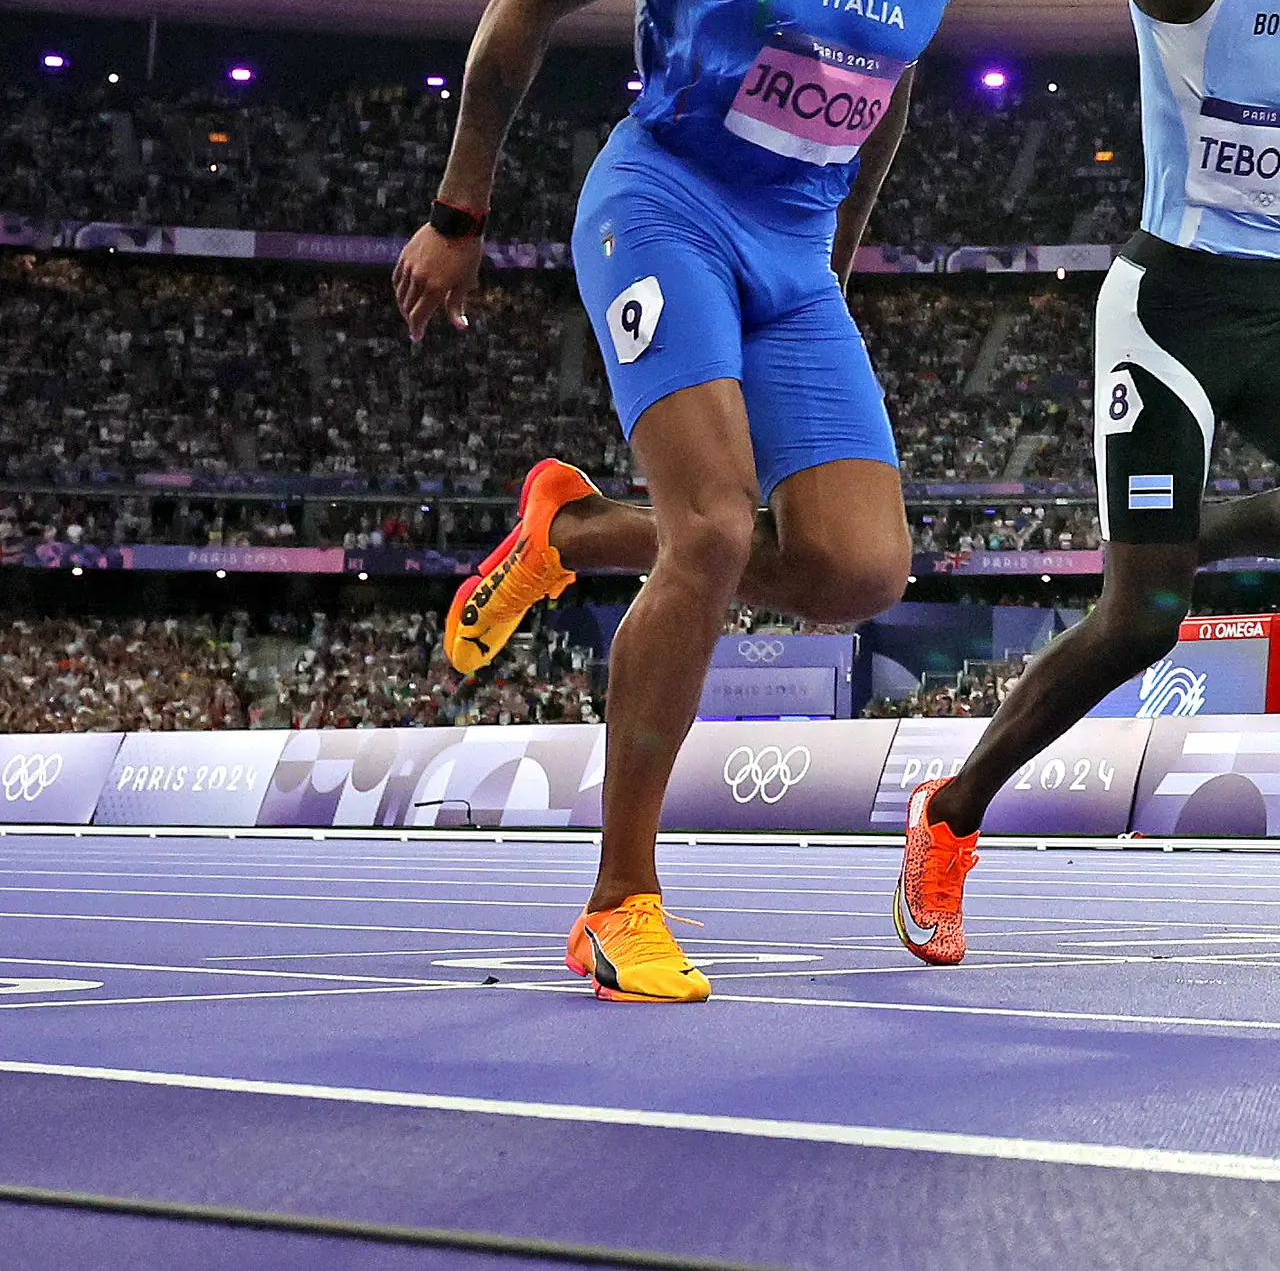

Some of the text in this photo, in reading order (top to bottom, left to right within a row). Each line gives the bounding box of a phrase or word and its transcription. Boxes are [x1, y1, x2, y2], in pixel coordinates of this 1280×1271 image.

[746, 63, 881, 131] JACOBS
[1242, 110, 1278, 122] PARIS
[622, 300, 642, 340] 9
[1109, 383, 1128, 420] 8
[982, 556, 1028, 568] PARIS
[1215, 622, 1263, 638] OMEGA
[116, 764, 258, 791] PARIS 2024
[1014, 758, 1115, 791] 2024
